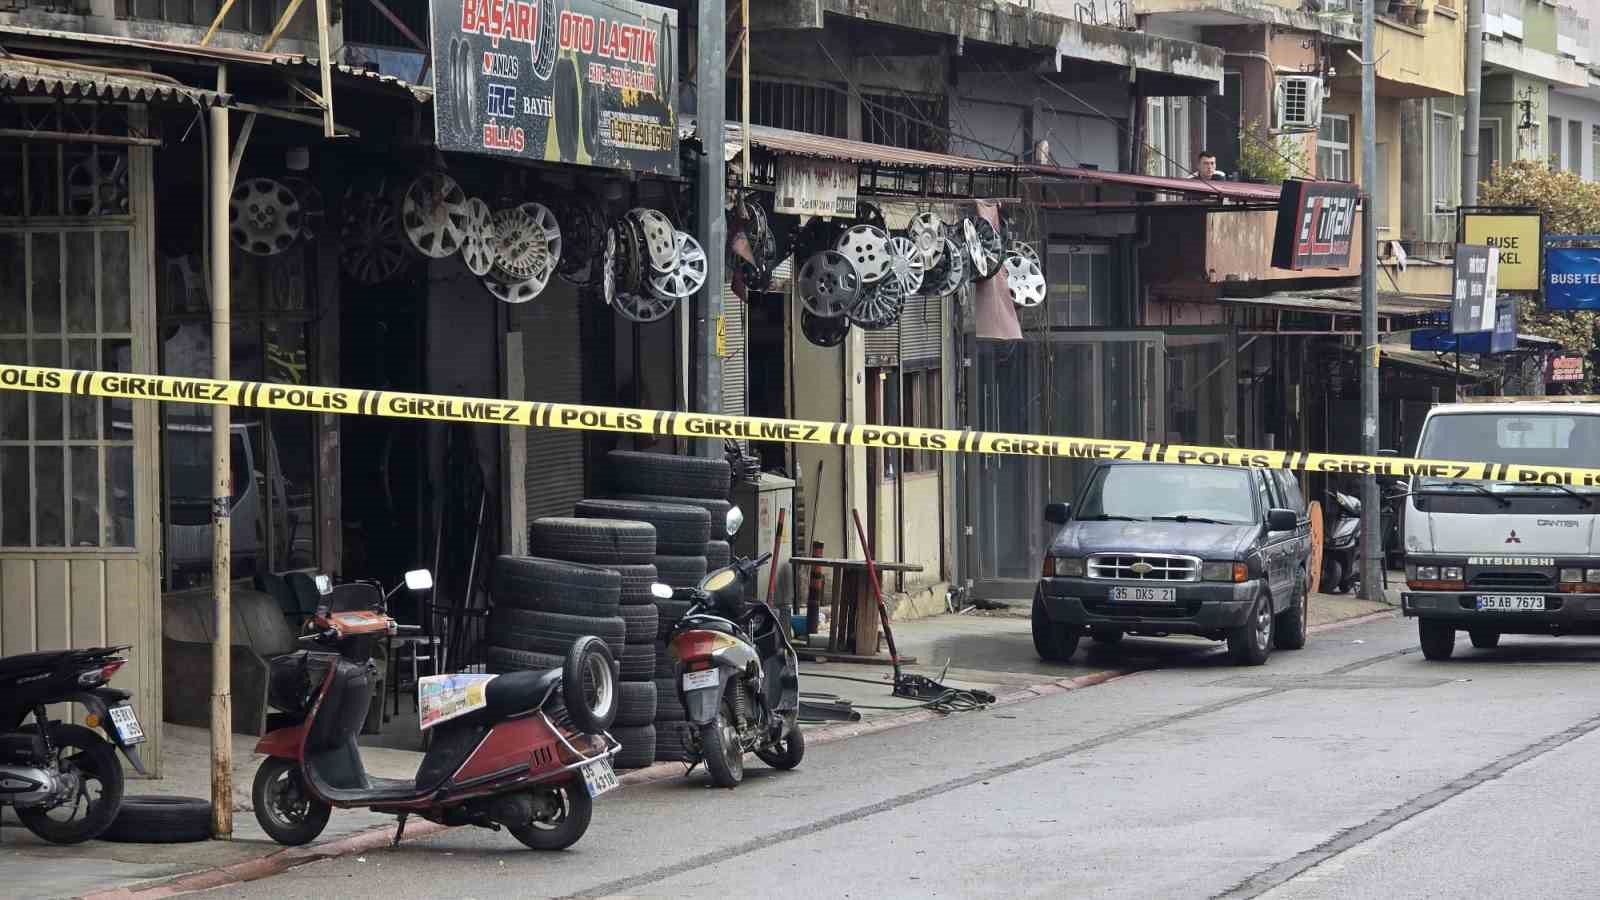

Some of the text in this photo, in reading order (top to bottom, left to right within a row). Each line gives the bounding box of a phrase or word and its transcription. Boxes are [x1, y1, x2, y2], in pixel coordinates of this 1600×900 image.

[559, 10, 594, 53] OTO
[599, 16, 657, 67] LASTİK
[484, 118, 524, 151] BİLLAS
[1487, 237, 1519, 248] BUSE
[1551, 274, 1581, 284] BUSE
[1468, 557, 1555, 566] MITSUBISHI
[1115, 588, 1174, 600] 35 DKS 21
[1482, 595, 1544, 609] 35 AB 7673
